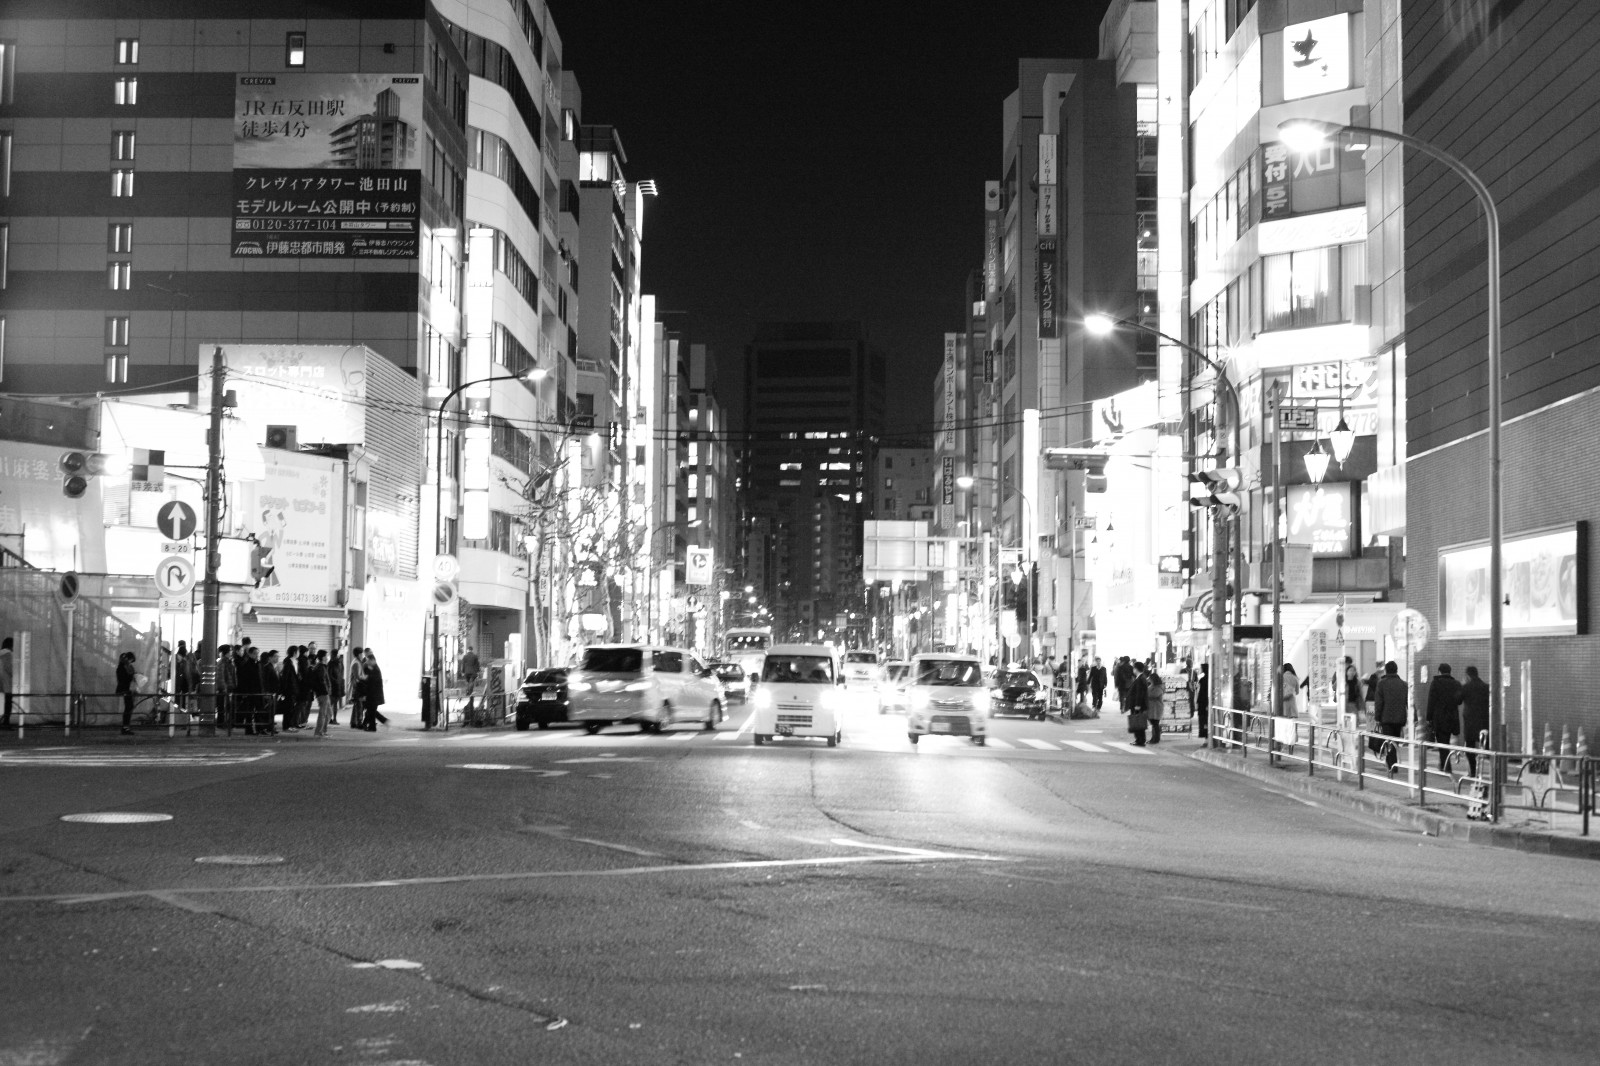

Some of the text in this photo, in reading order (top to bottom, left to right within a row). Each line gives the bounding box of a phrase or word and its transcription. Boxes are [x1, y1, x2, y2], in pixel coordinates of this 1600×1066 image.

[242, 99, 345, 117] JR五反田駅
[242, 120, 310, 138] 徒歩4分
[252, 219, 336, 230] 0120-377-104
[266, 241, 345, 254] 伊藤忠都市開発
[1039, 241, 1055, 250] citi
[131, 482, 163, 492] 時差式
